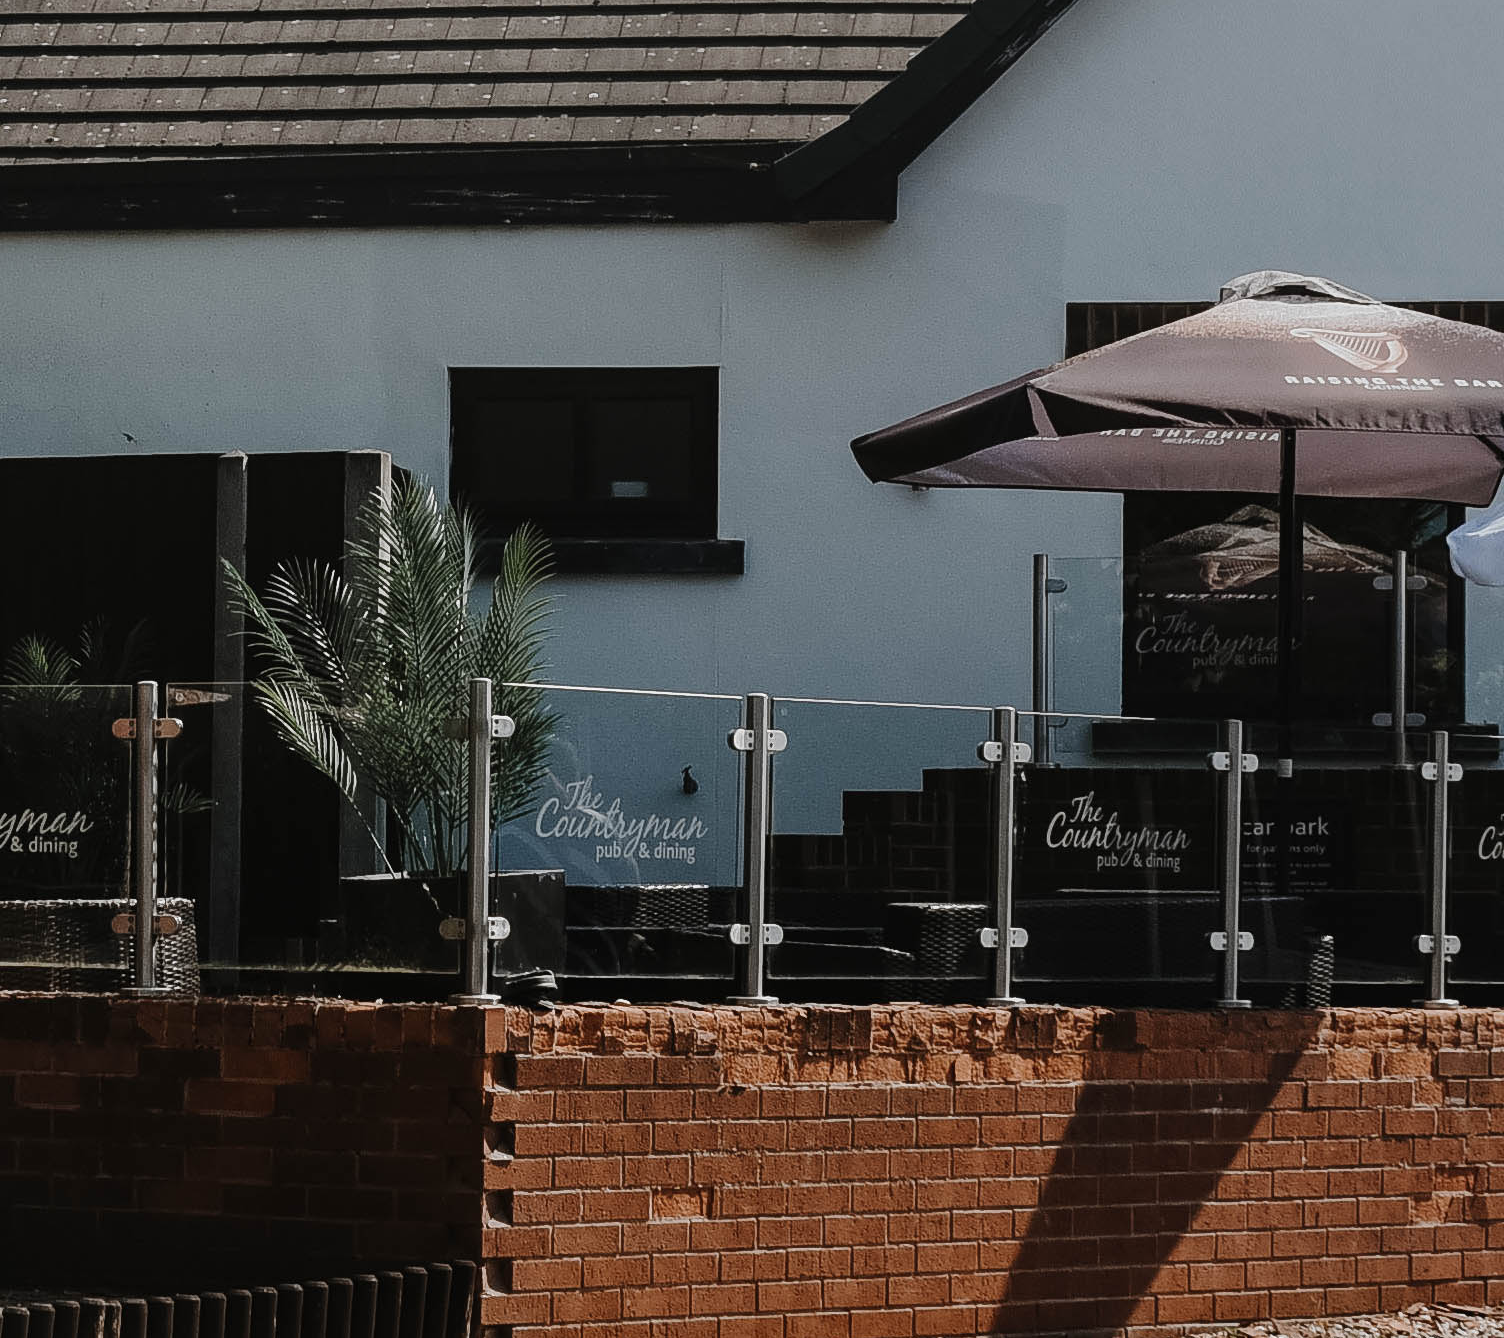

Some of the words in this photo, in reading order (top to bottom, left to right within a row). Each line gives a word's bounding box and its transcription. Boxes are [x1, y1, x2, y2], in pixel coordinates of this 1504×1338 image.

[1284, 375, 1387, 386] RAISING
[1396, 377, 1445, 387] THE
[1453, 378, 1504, 388] BAR
[564, 775, 604, 811] The
[1070, 791, 1104, 823] The
[535, 797, 709, 858] Countryman
[1290, 815, 1329, 836] ark
[10, 836, 24, 852] &
[28, 836, 79, 859] dining
[1046, 811, 1192, 866] Countryman
[596, 841, 622, 862] pub
[638, 842, 651, 859] &
[654, 842, 696, 864] dining
[1097, 852, 1119, 872] pub
[1133, 852, 1143, 868] &
[1145, 852, 1181, 873] dining
